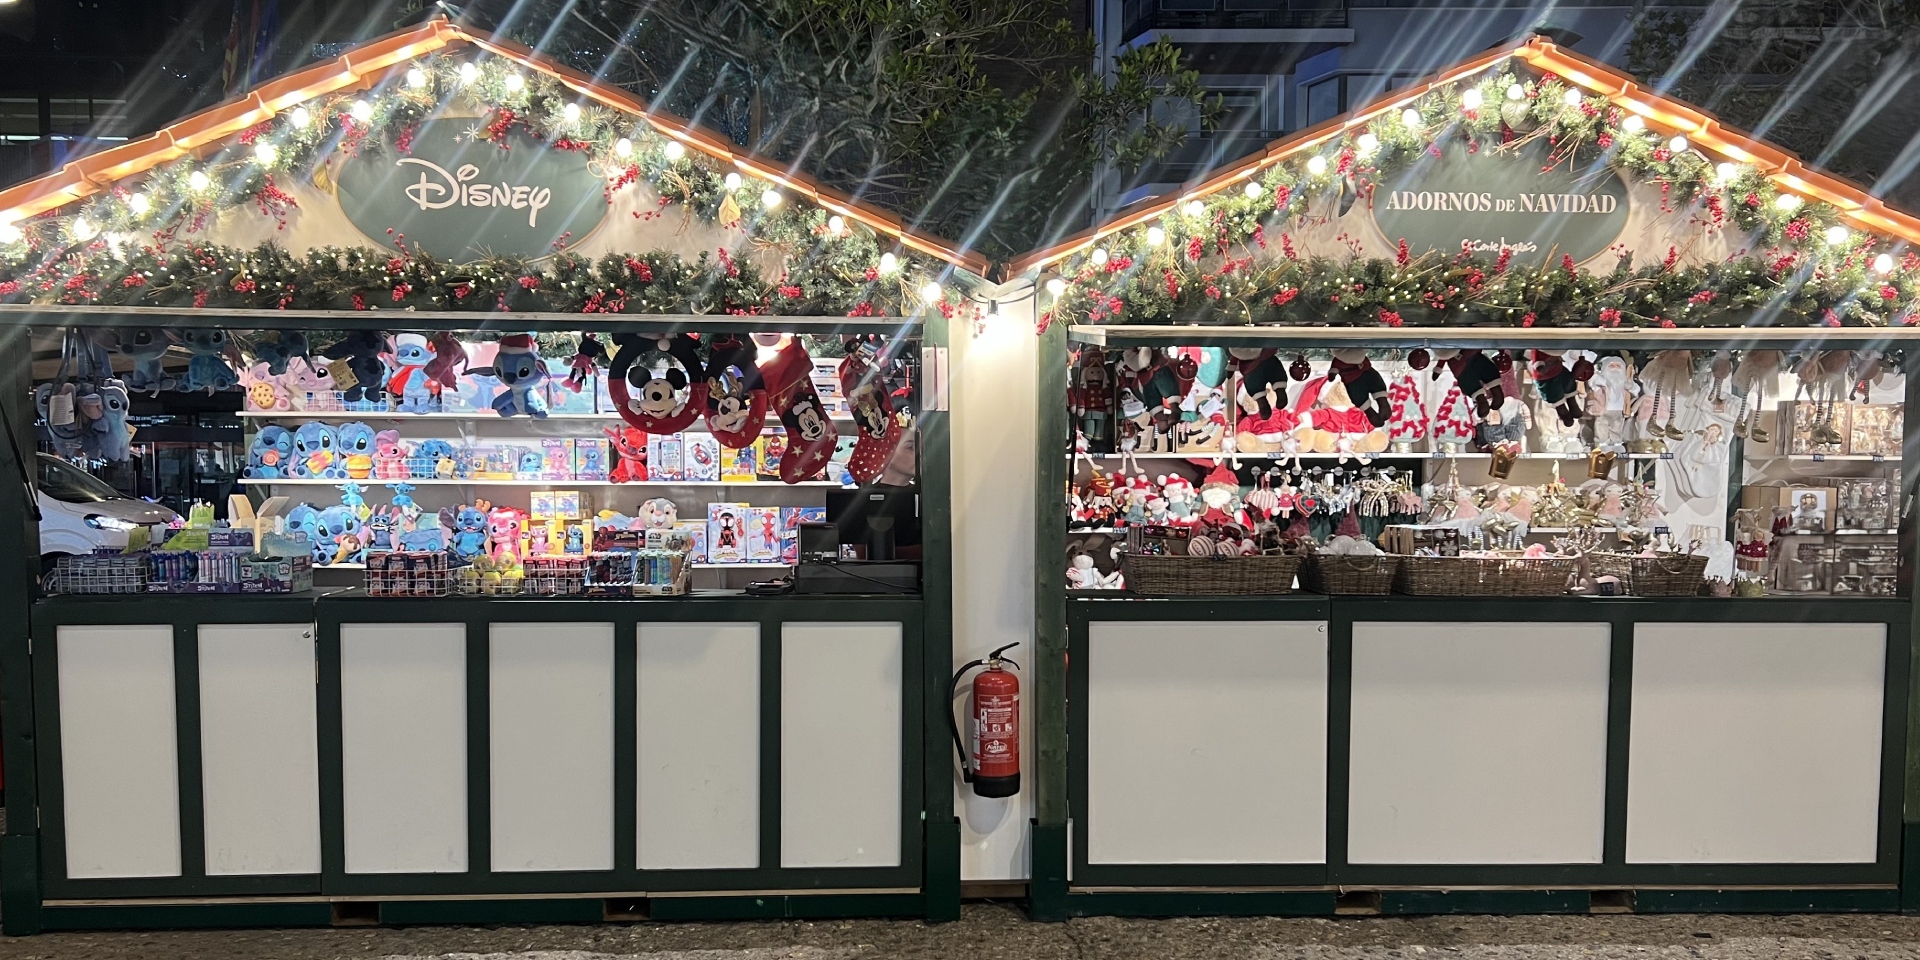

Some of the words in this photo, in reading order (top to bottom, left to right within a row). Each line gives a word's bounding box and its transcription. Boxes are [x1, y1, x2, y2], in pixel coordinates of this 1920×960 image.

[1385, 190, 1492, 212] ADORNOS
[1495, 199, 1515, 212] DE
[1519, 193, 1617, 214] NAVIDAD
[1473, 239, 1499, 252] Corte
[1499, 236, 1538, 256] Inglés
